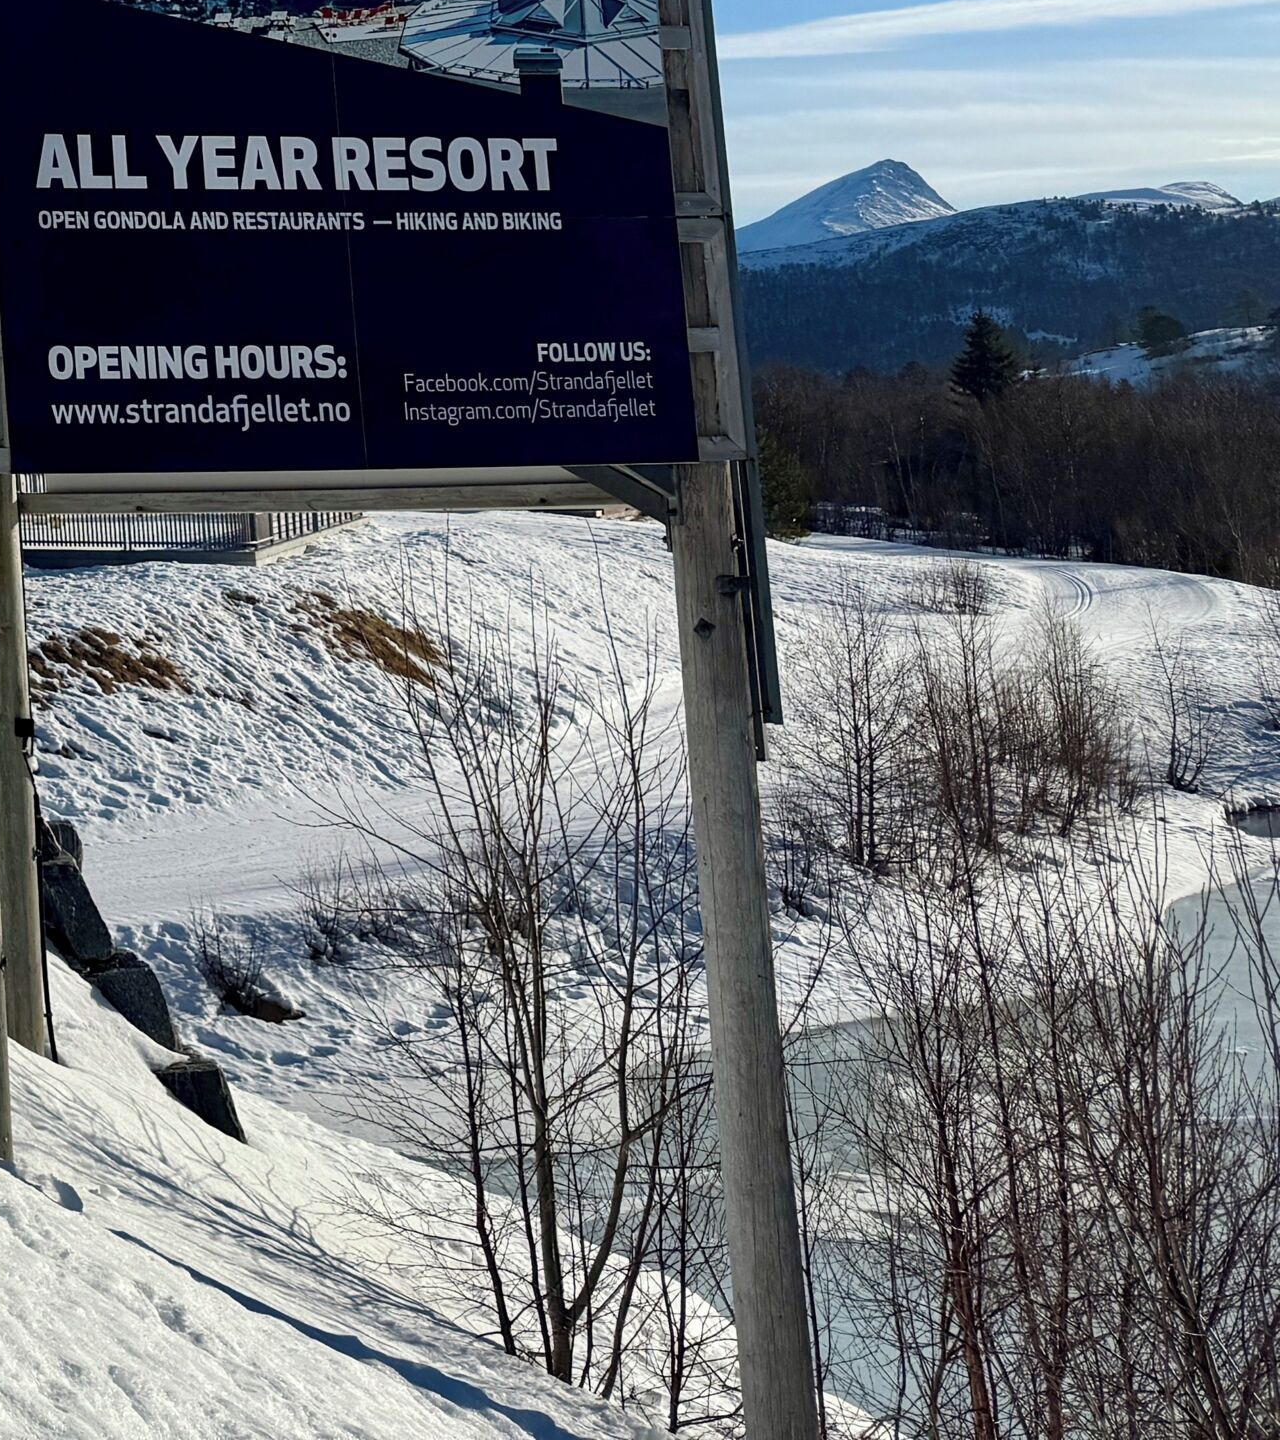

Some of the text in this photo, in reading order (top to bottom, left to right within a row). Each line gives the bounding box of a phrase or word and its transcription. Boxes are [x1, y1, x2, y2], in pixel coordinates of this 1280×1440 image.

[36, 133, 557, 192] ALL YEAR RESORT
[38, 210, 90, 229] OPEN
[93, 210, 186, 230] GONDOLA
[190, 211, 229, 230] AND
[232, 211, 365, 231] RESTAURANTS
[396, 212, 458, 231] HIKING
[462, 212, 499, 231] AND
[502, 212, 562, 231] BIKING
[48, 344, 348, 380] OPENING HOURS:
[537, 342, 652, 363] FOLLOW US:
[403, 370, 654, 396] Facebook.com/Strandafjellet
[51, 394, 351, 432] www.strandafjellet.no
[404, 398, 657, 426] Instagram.com/Strandafjellet
